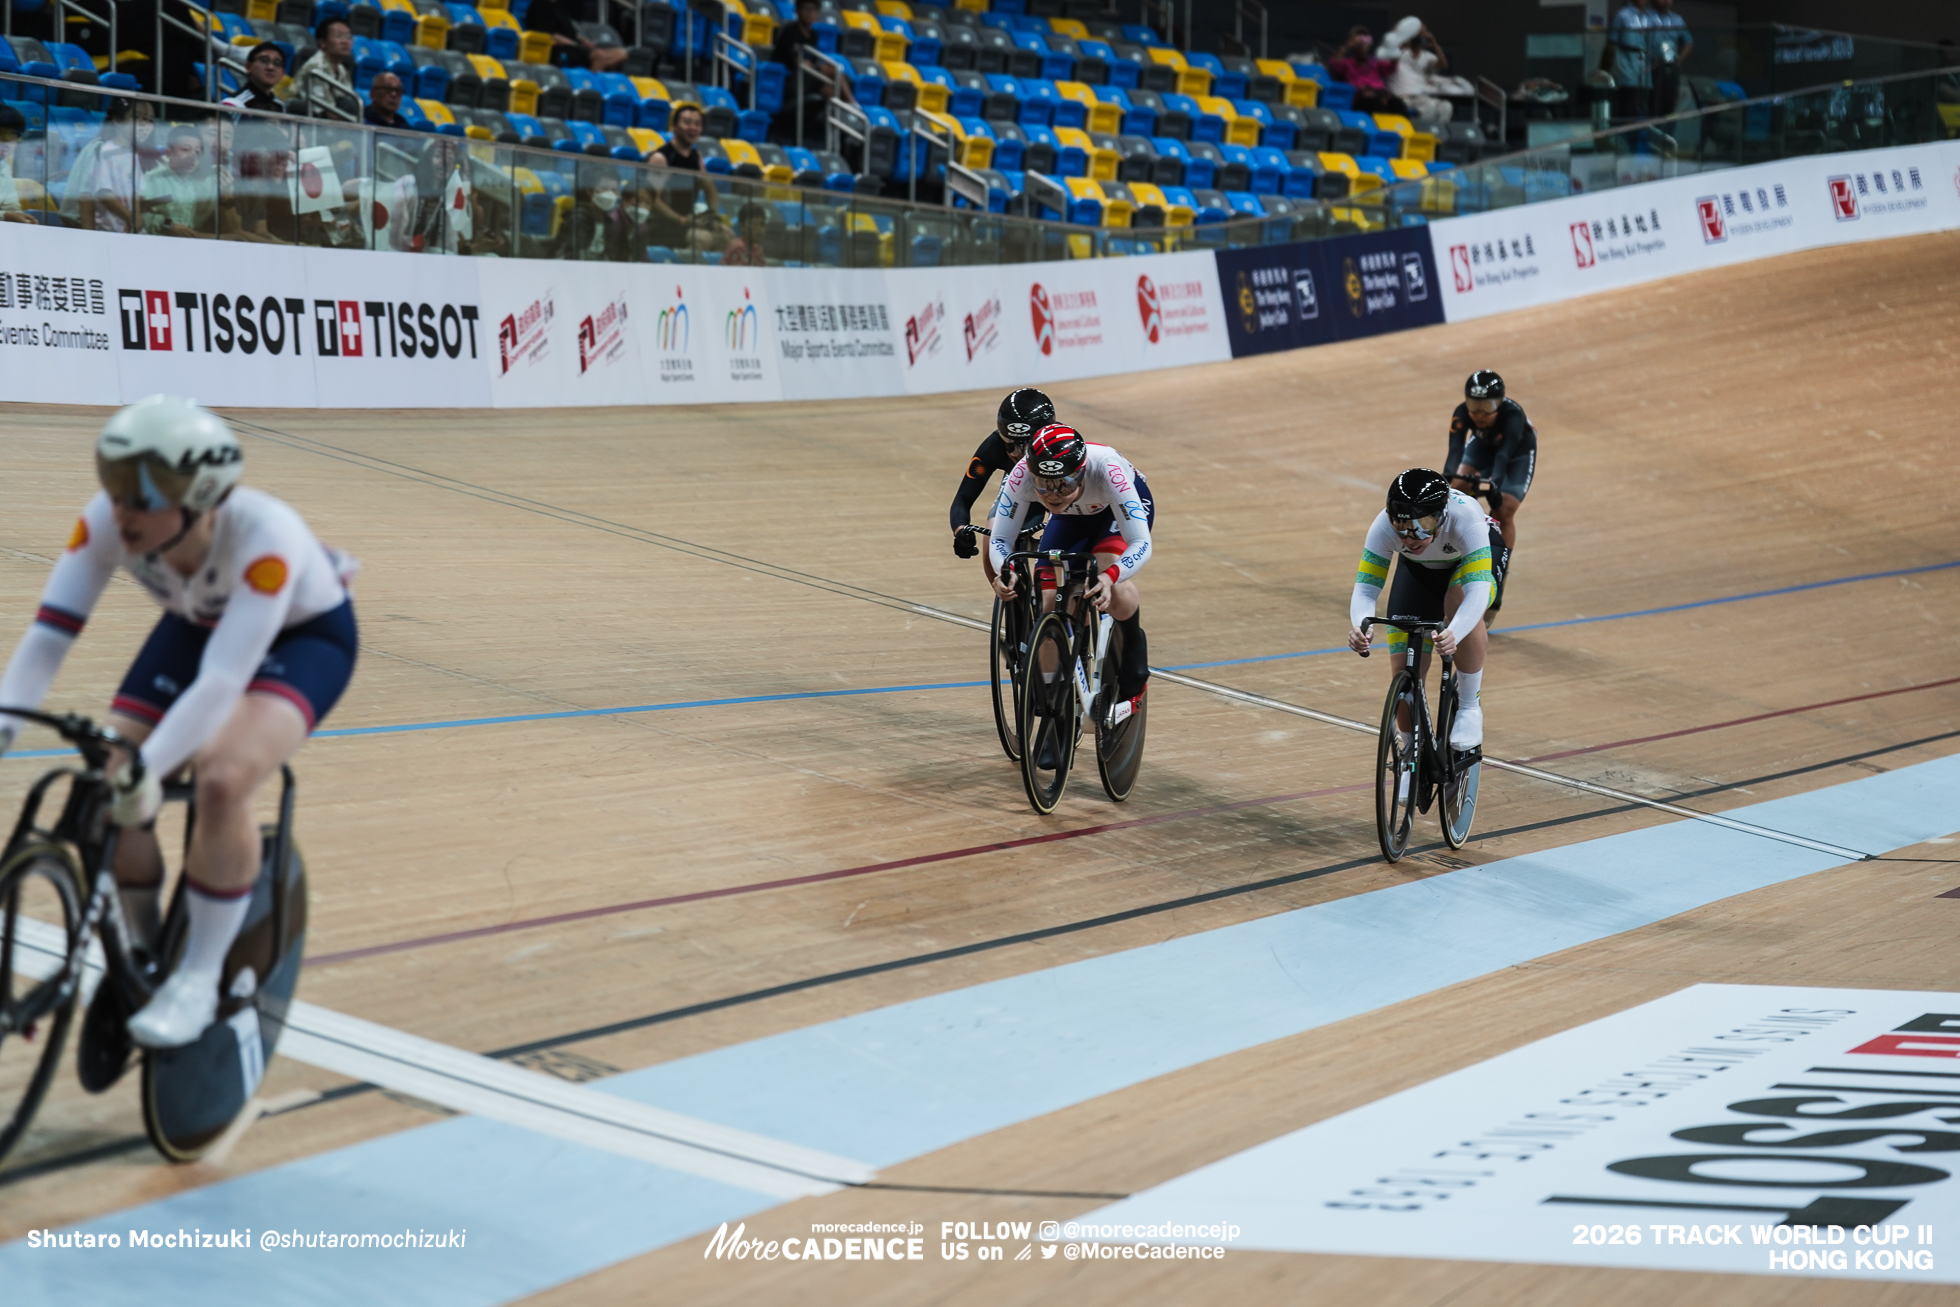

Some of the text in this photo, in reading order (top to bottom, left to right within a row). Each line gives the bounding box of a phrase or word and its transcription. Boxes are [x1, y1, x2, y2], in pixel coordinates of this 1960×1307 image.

[43, 322, 109, 350] Committee
[174, 291, 305, 355] TISSOT
[364, 301, 479, 359] TISSOT
